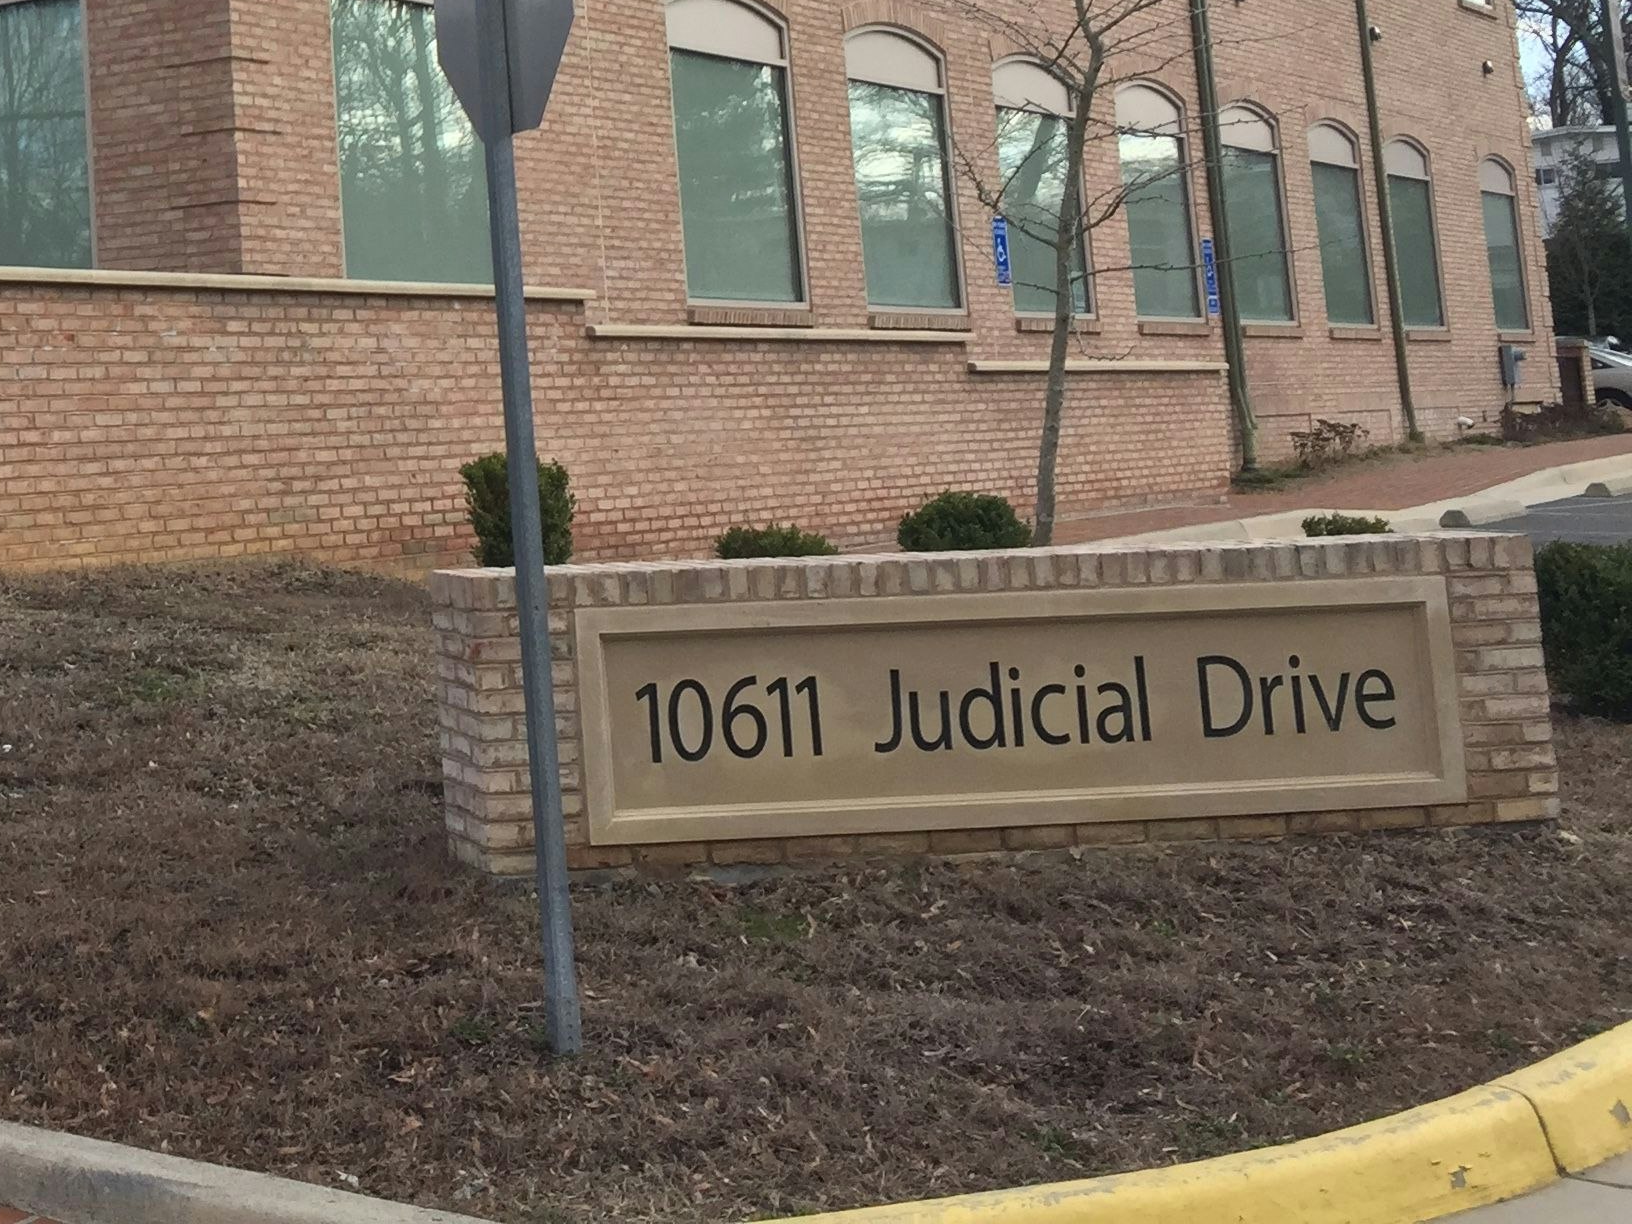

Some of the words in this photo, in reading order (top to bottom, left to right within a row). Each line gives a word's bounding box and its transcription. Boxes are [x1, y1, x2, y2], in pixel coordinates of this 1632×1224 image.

[634, 675, 824, 764] 10611
[874, 655, 1152, 754] Judicial
[1196, 654, 1397, 738] Drive
